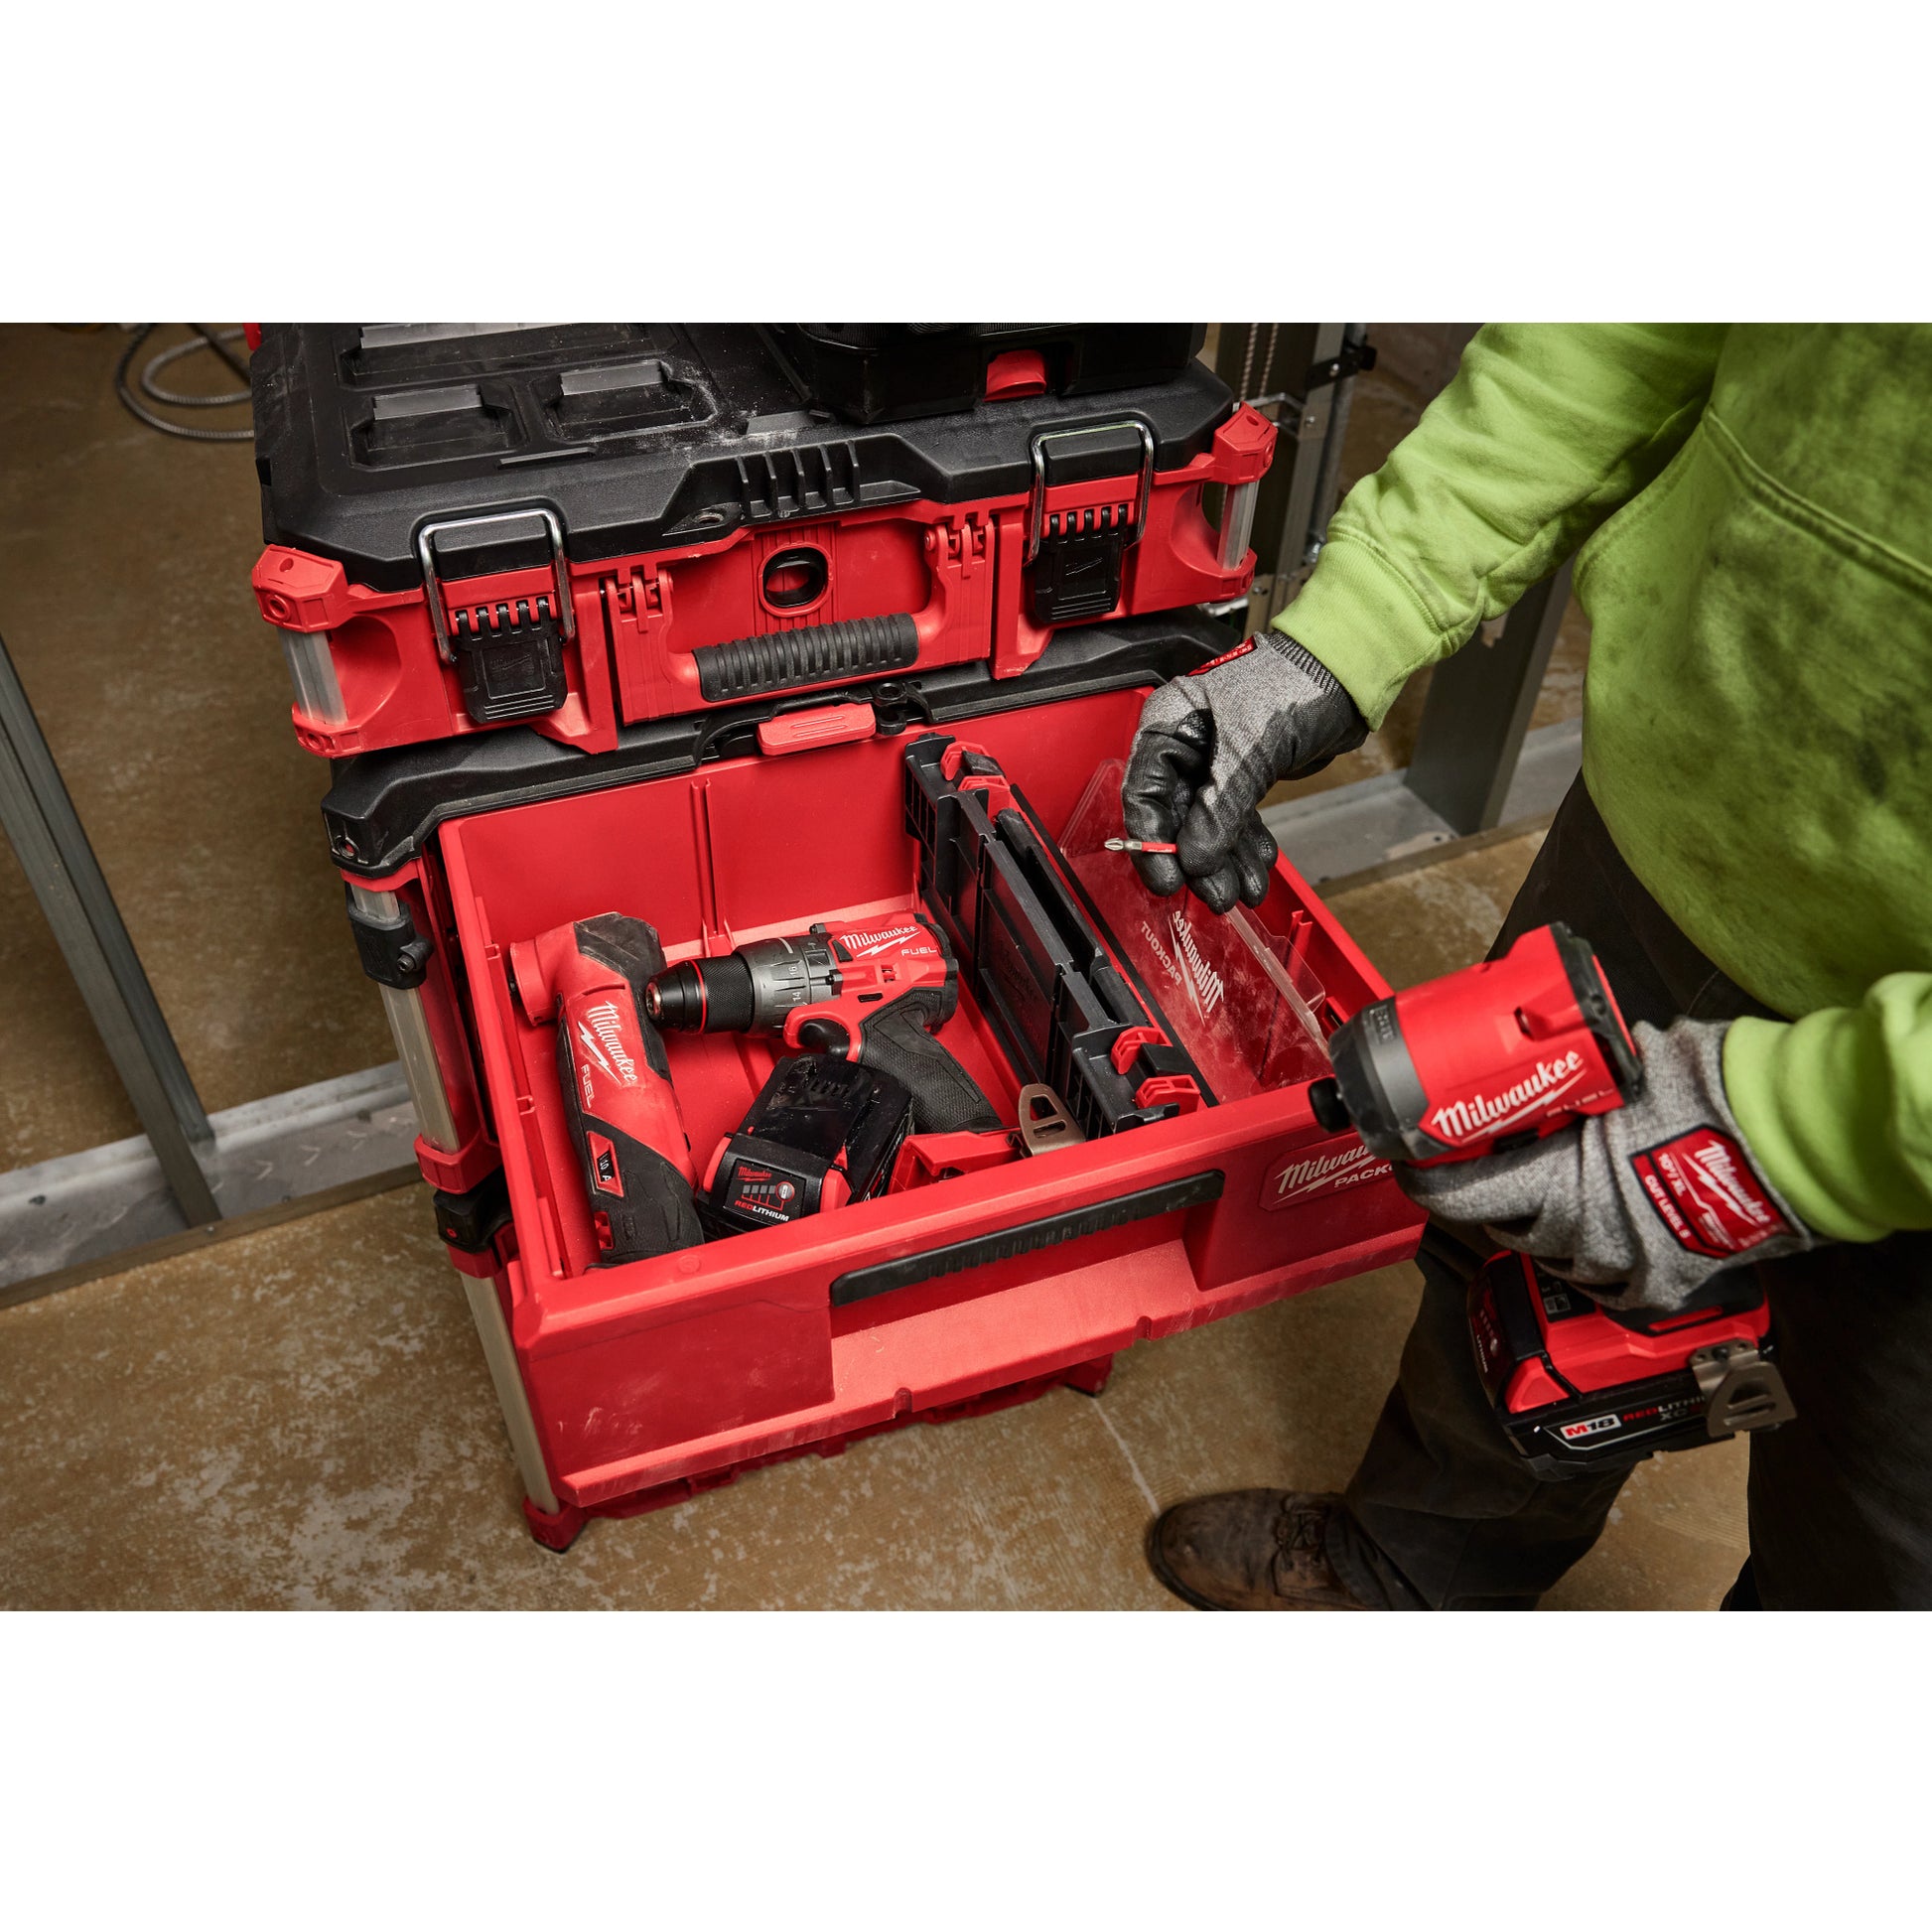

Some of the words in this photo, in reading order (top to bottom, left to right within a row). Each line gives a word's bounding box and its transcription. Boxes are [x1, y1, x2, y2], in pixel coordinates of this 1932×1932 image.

[839, 925, 918, 950] Milwaukee
[900, 946, 938, 956] FUEL
[587, 1000, 638, 1084] Milwaukee
[581, 1063, 595, 1109] FUEL
[1431, 1050, 1585, 1138] Milwaukee
[1274, 1145, 1370, 1194] Milwau
[1334, 1163, 1393, 1188] PACK
[1565, 1417, 1616, 1438] M18
